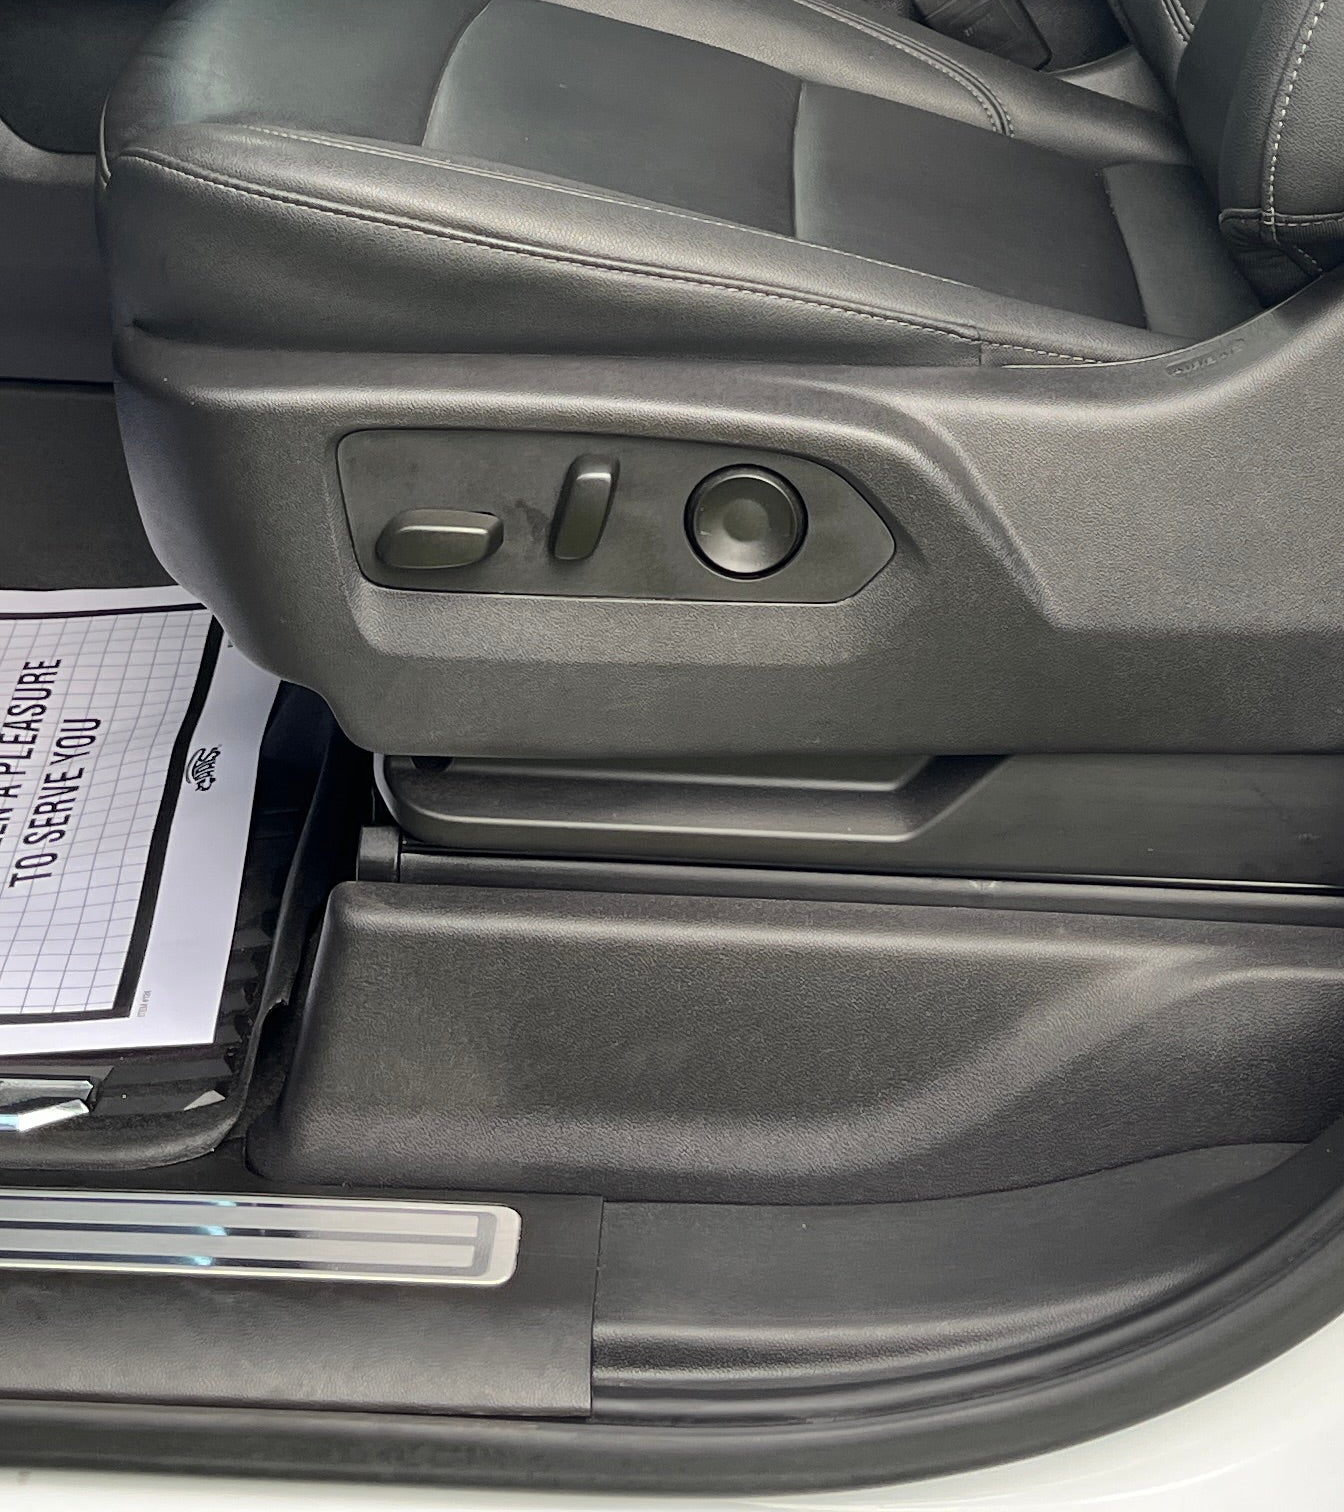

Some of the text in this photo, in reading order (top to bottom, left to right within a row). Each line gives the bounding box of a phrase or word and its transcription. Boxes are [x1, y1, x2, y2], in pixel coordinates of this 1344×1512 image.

[9, 717, 101, 888] TO SERVE YOU
